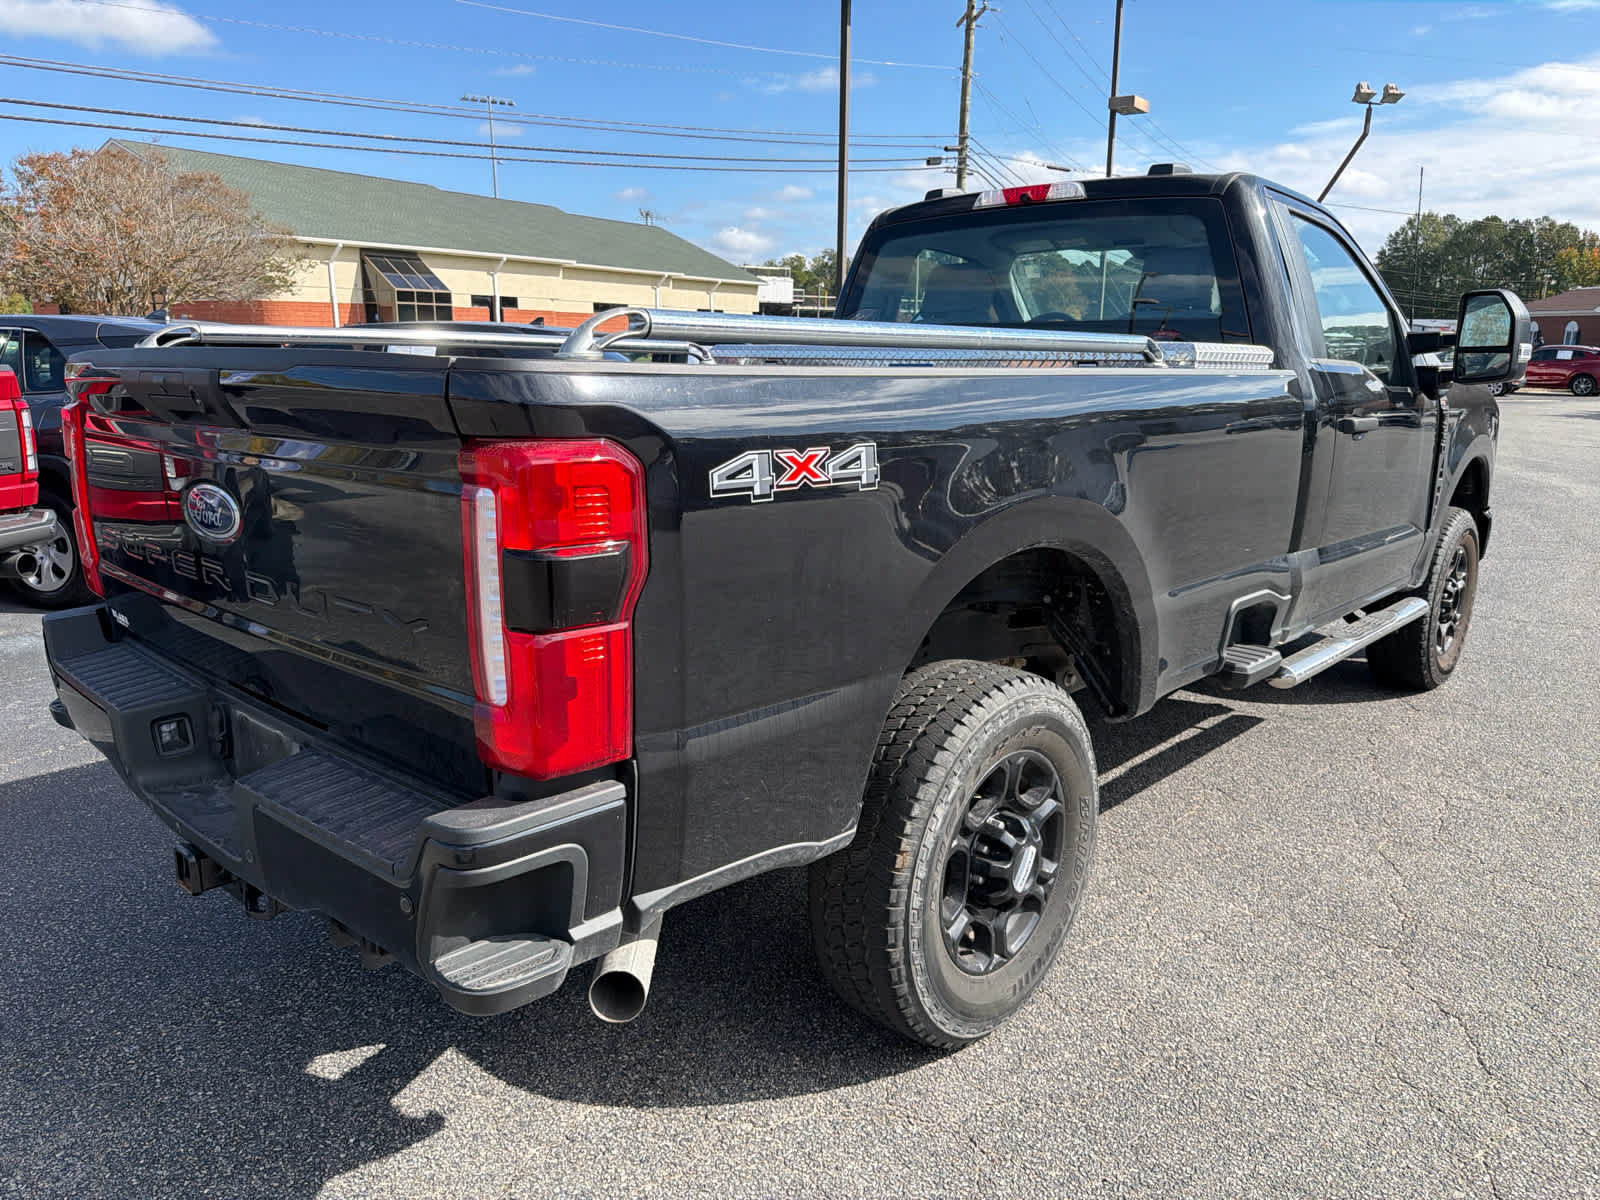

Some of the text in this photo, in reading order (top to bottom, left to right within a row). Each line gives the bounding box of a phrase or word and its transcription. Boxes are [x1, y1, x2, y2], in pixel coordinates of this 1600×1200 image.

[709, 442, 881, 503] 4X4
[101, 526, 430, 643] SUPER DUTY
